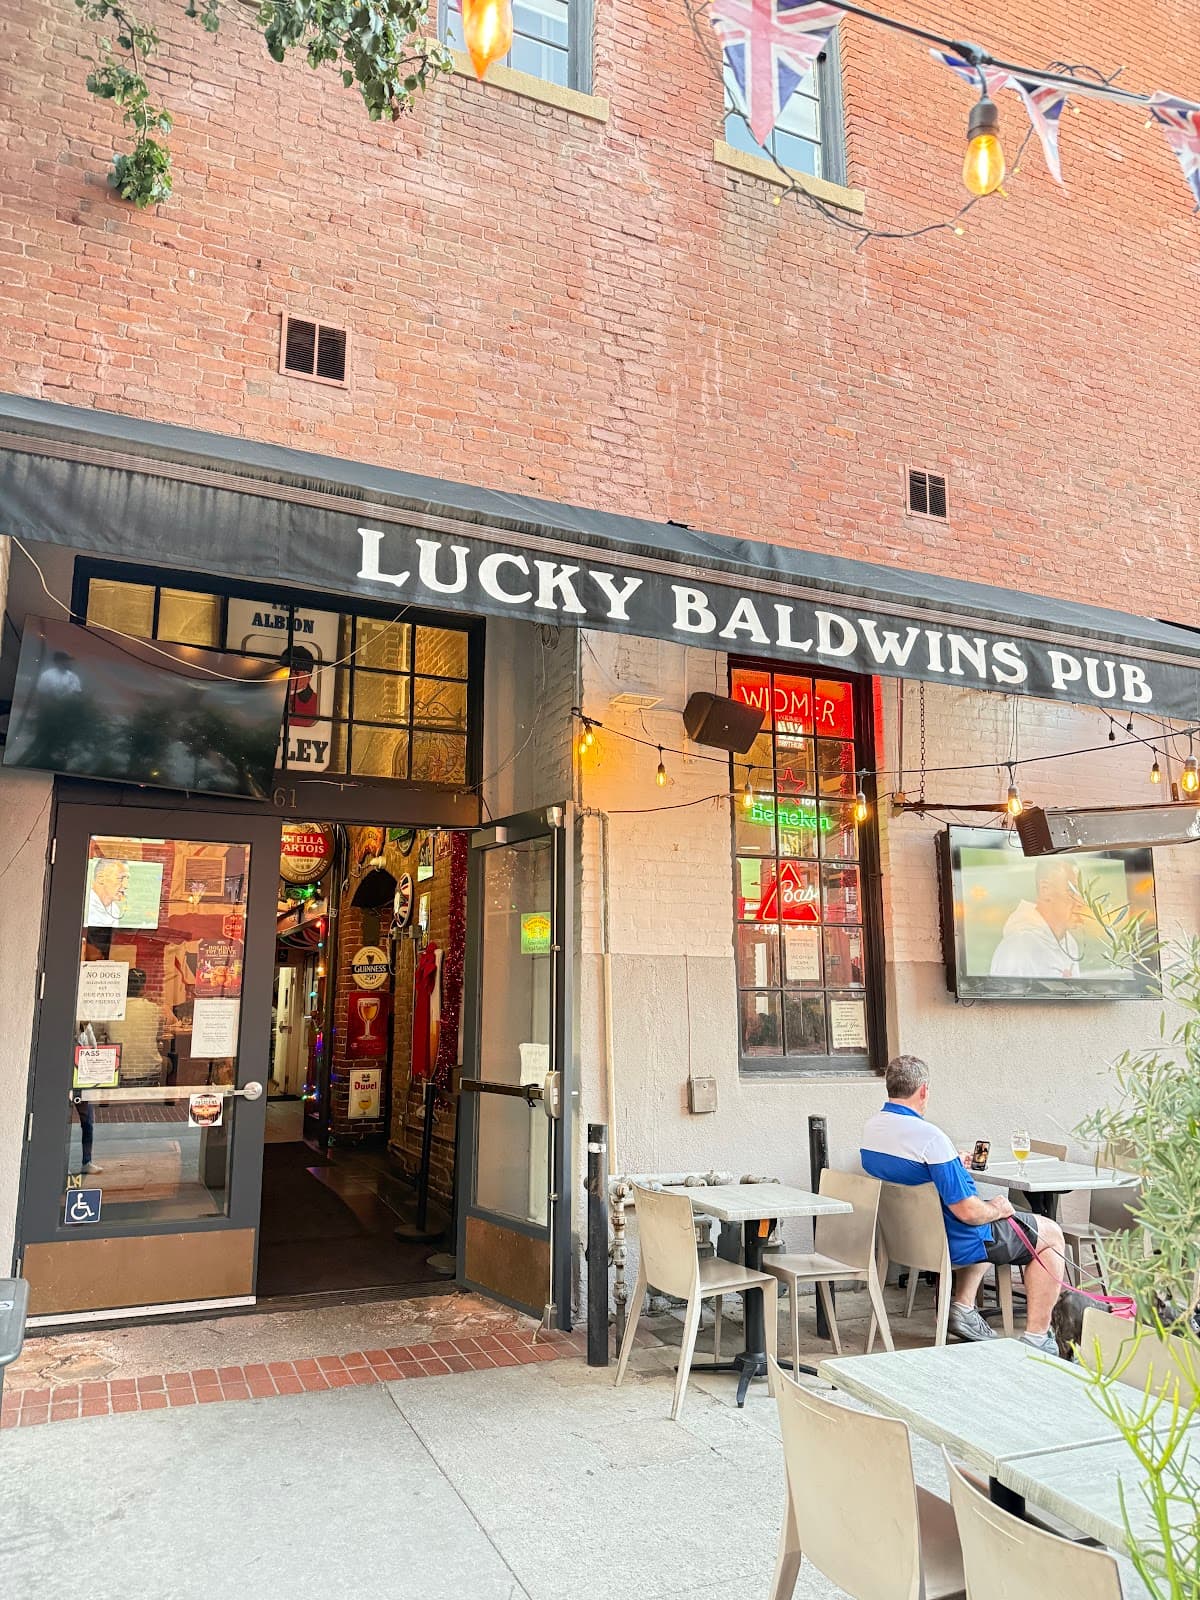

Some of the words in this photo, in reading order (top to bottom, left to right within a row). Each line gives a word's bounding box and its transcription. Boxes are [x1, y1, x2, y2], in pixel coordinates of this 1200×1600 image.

[356, 528, 643, 620] LUCKY
[671, 584, 1028, 684] BALDWINS
[1047, 650, 1154, 704] PUB
[741, 686, 834, 726] WIDMR
[279, 737, 328, 764] LEY
[273, 788, 296, 808] 61
[281, 835, 324, 844] STELLA
[282, 844, 325, 854] ARTOIS
[781, 880, 820, 902] Bas
[354, 965, 386, 973] GUINNESS
[355, 1082, 377, 1090] Duvel
